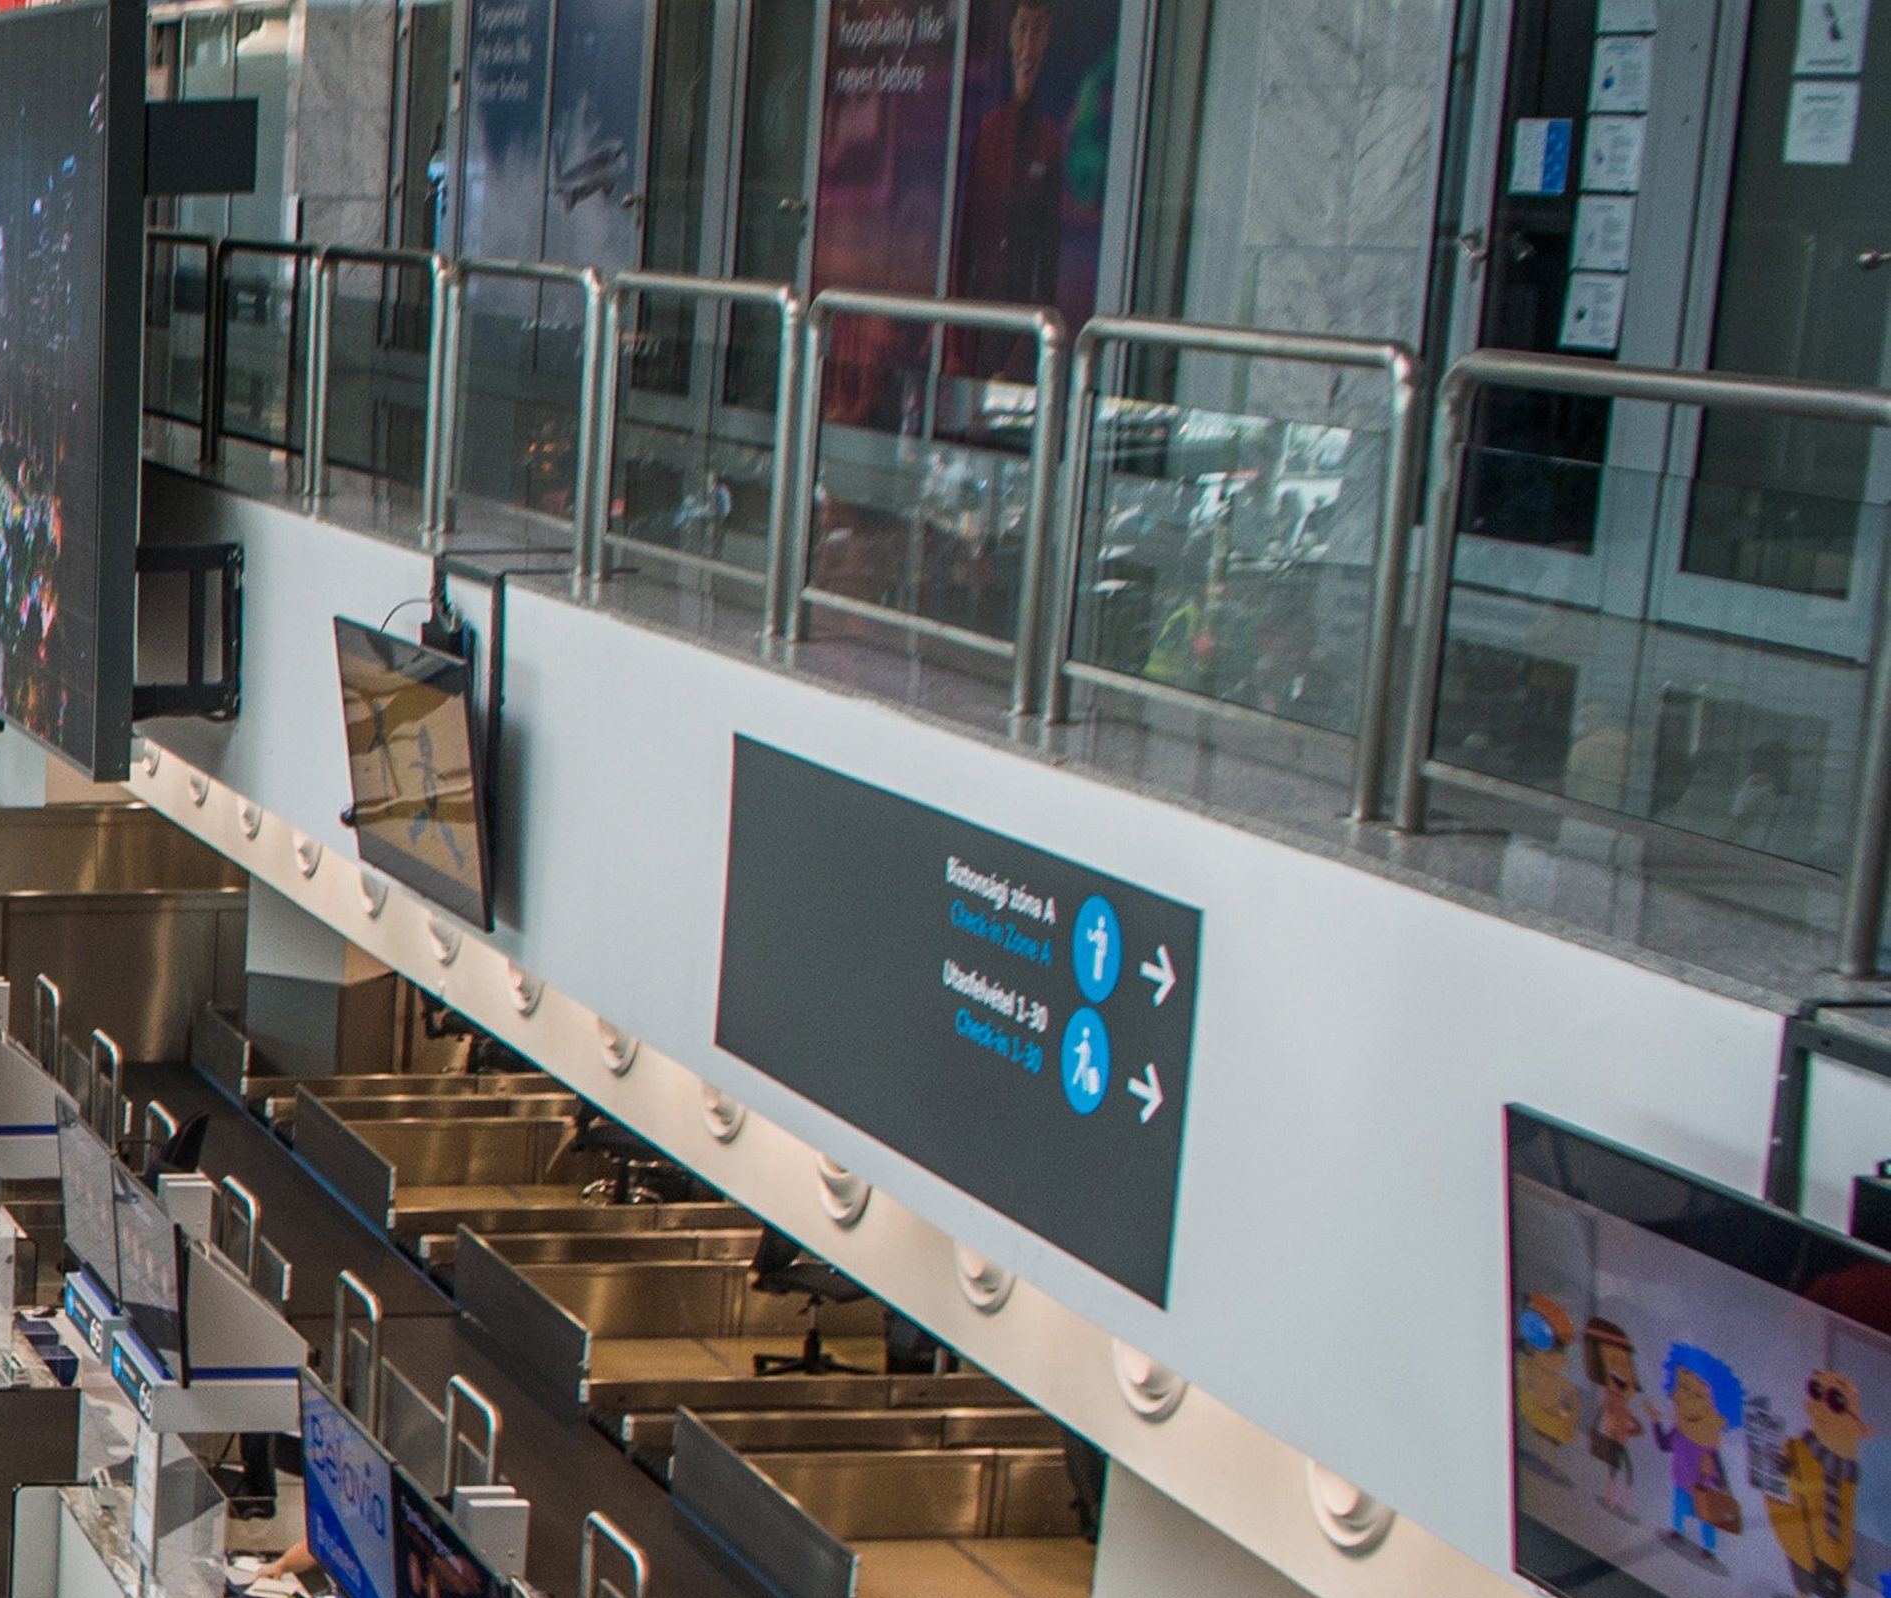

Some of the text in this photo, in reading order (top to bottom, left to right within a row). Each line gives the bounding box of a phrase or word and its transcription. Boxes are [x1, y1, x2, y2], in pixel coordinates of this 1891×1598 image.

[839, 5, 945, 55] hospitality like
[835, 55, 925, 93] never before
[951, 899, 1053, 966] Check-in Zone A
[1041, 897, 1057, 926] A
[943, 959, 1049, 1033] Utasfelvétel 1-30
[955, 1007, 1044, 1074] Check-in 1-30
[310, 1412, 388, 1544] Belavia
